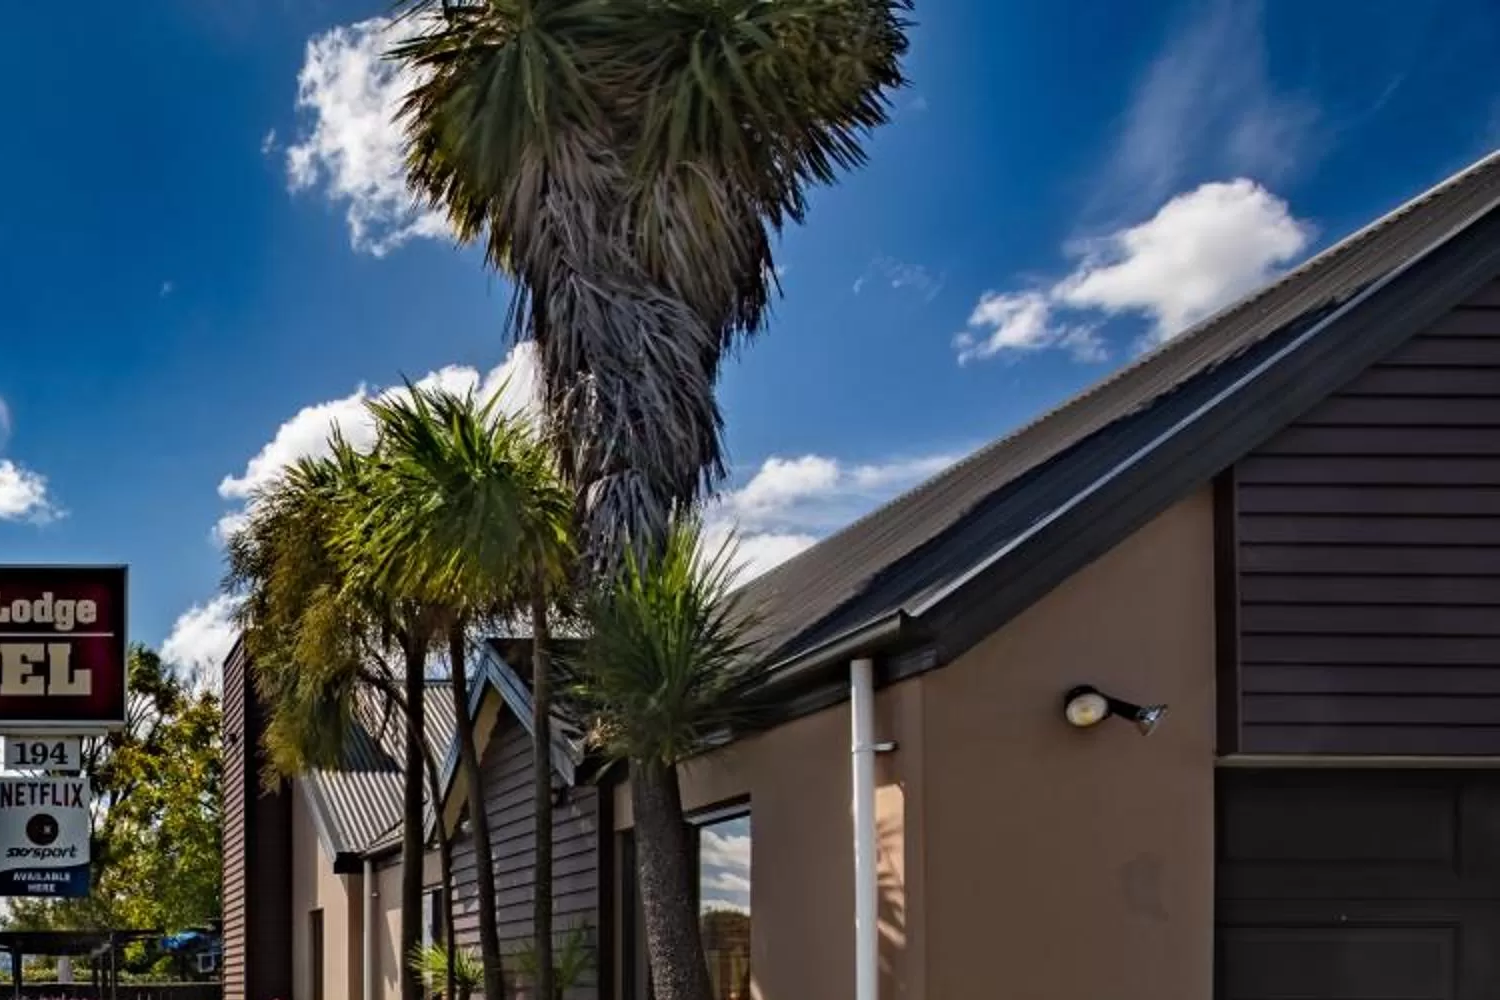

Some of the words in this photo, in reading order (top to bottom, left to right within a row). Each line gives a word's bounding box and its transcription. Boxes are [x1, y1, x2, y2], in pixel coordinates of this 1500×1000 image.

[14, 742, 69, 766] 194
[0, 781, 84, 809] NETFLIX
[13, 871, 71, 882] AVAILABLE
[27, 883, 56, 893] HERE
